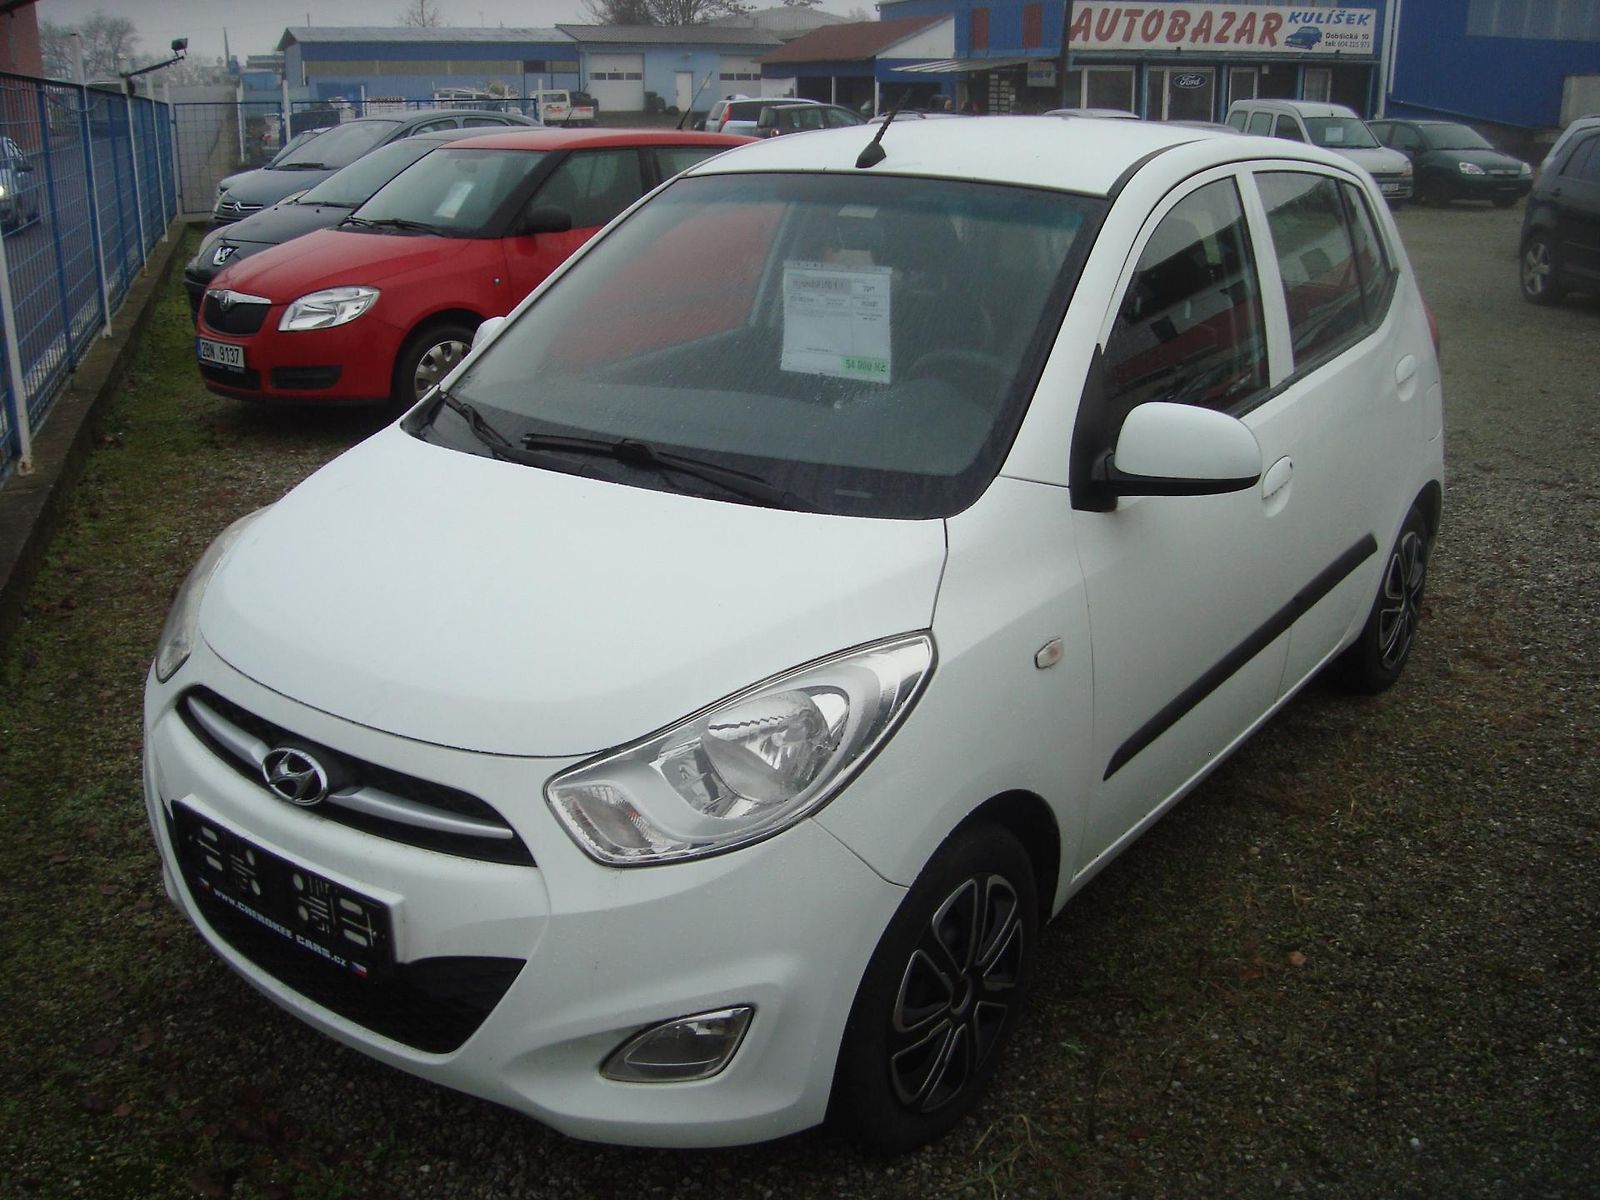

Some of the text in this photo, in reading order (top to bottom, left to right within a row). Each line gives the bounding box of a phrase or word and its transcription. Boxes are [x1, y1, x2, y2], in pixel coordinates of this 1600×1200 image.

[1287, 10, 1371, 26] KULÍŠEK
[1069, 7, 1283, 47] AUTOBAZAR
[1179, 75, 1201, 86] Ford
